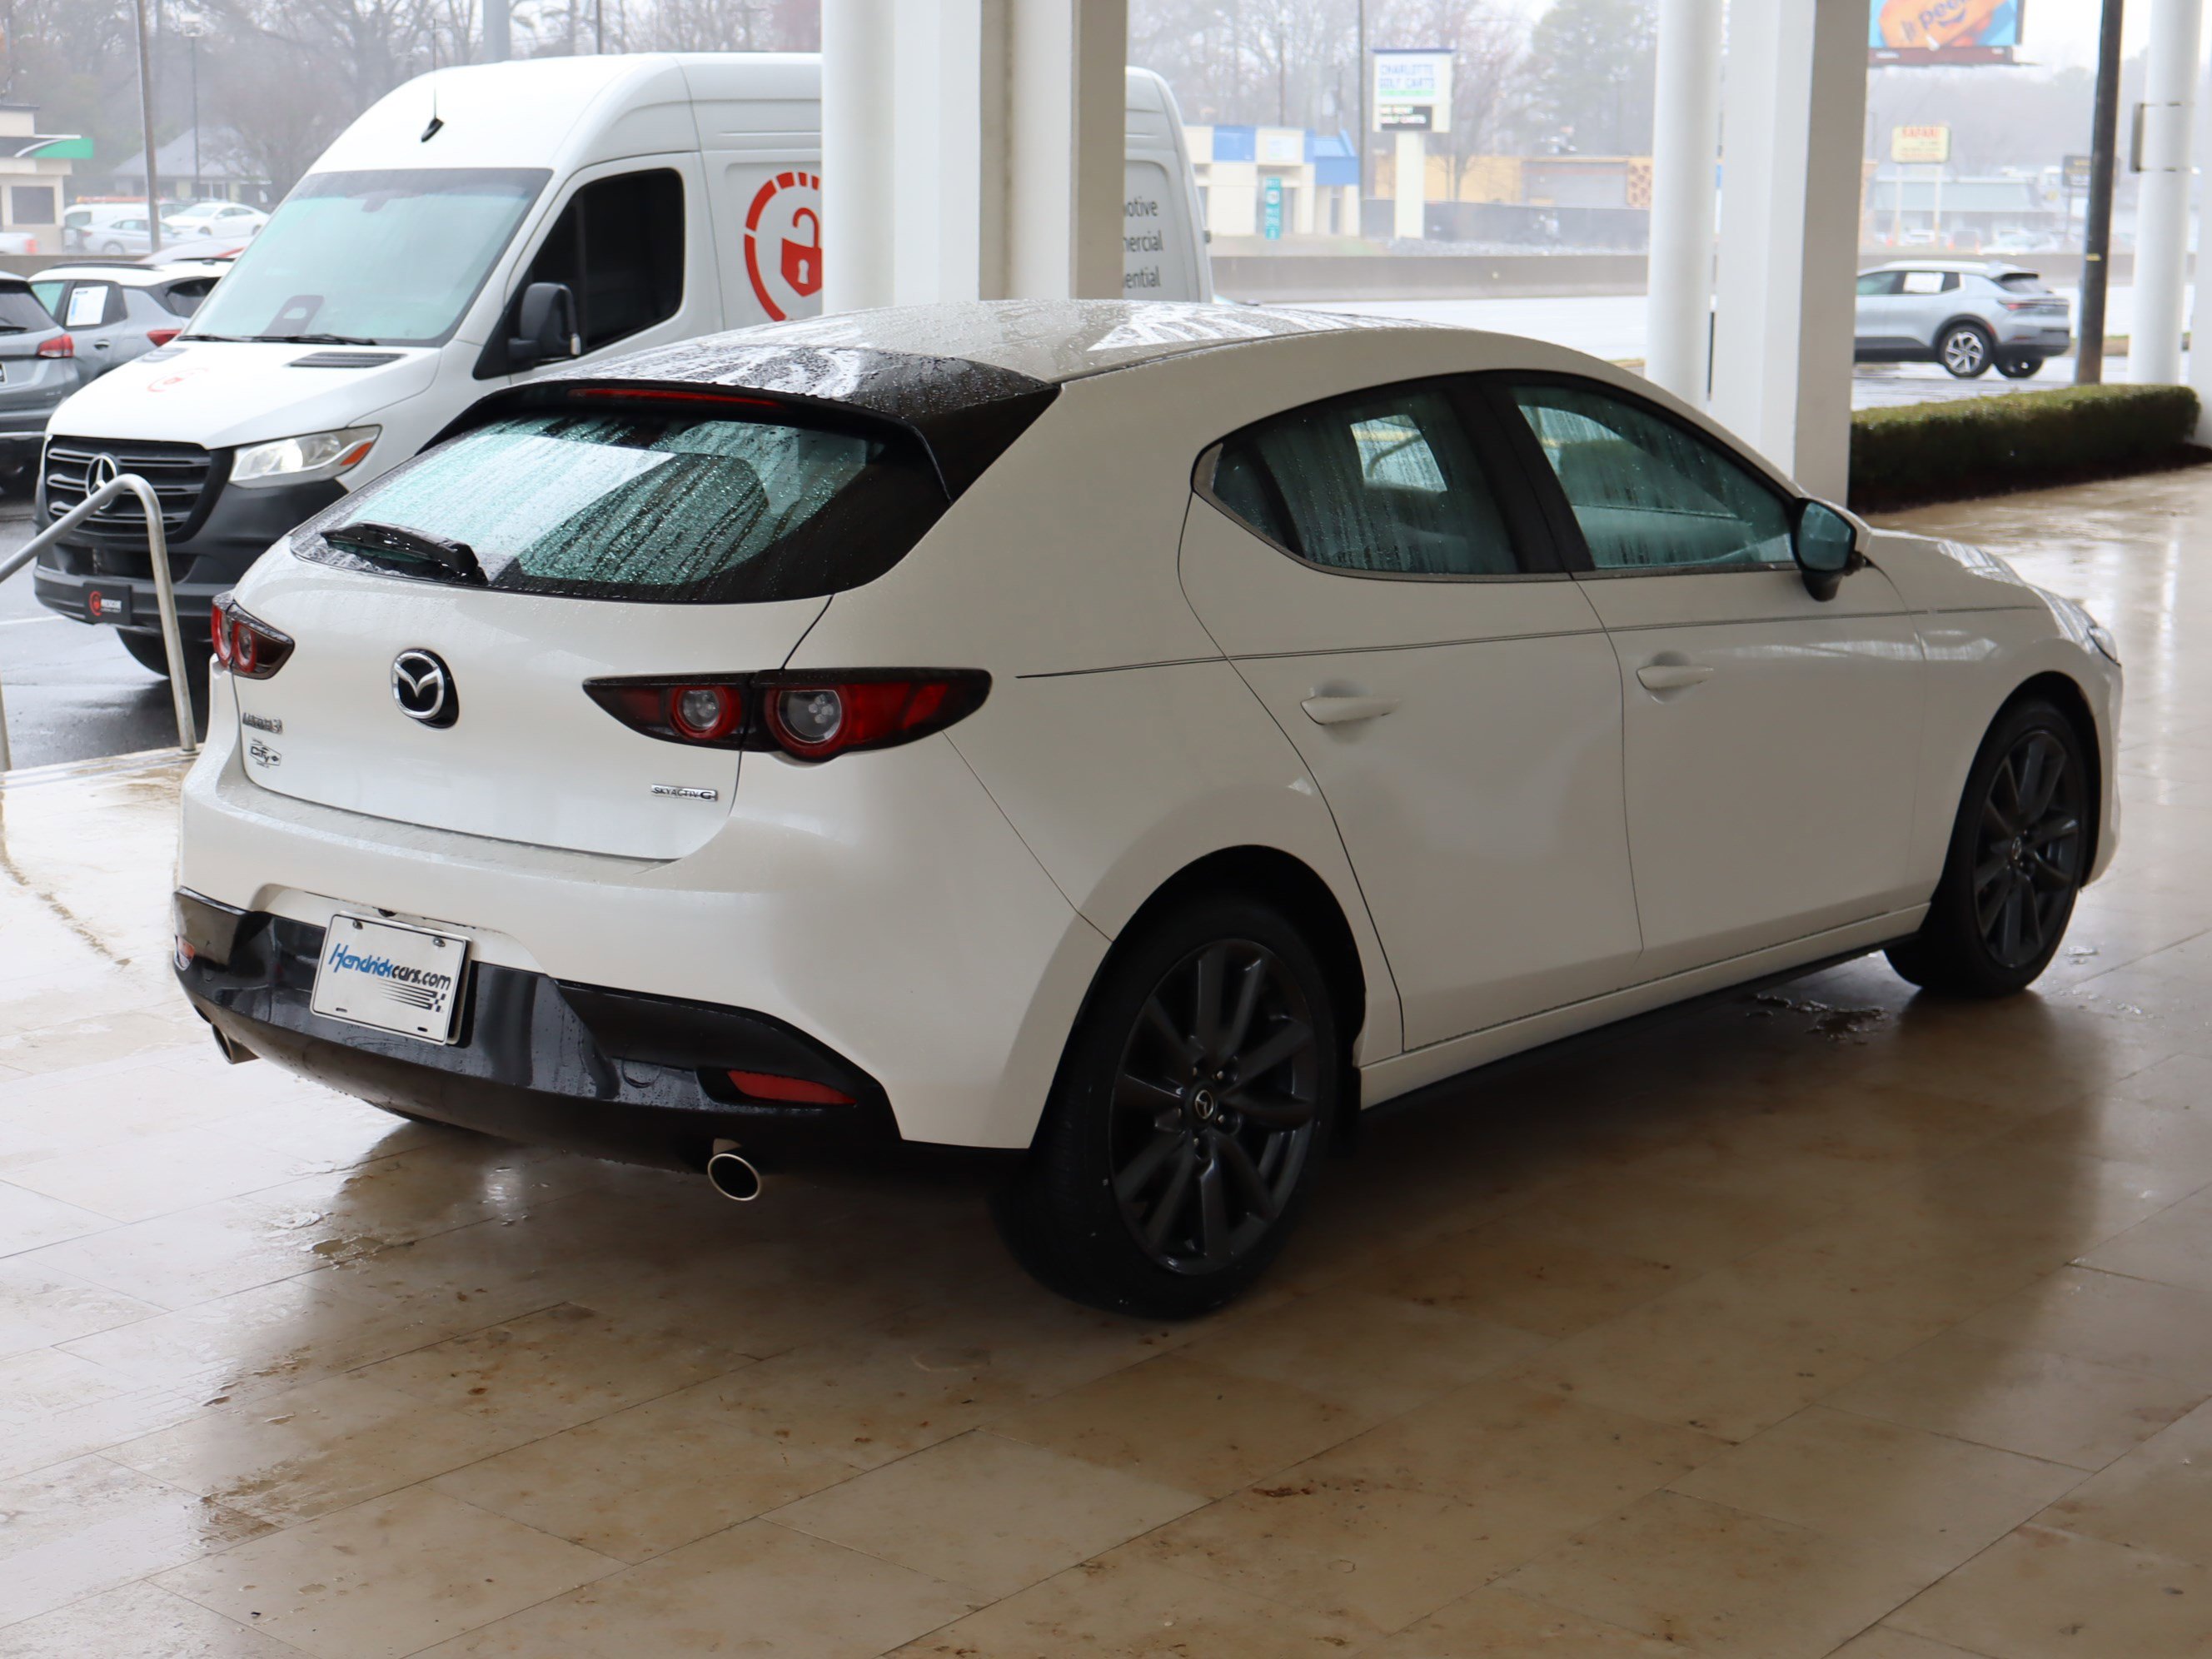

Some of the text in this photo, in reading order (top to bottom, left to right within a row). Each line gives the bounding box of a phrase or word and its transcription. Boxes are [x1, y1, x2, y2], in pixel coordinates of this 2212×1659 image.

[1124, 197, 1159, 217] otive
[1123, 265, 1162, 289] ential
[328, 942, 451, 991] Hendrickcars.com
